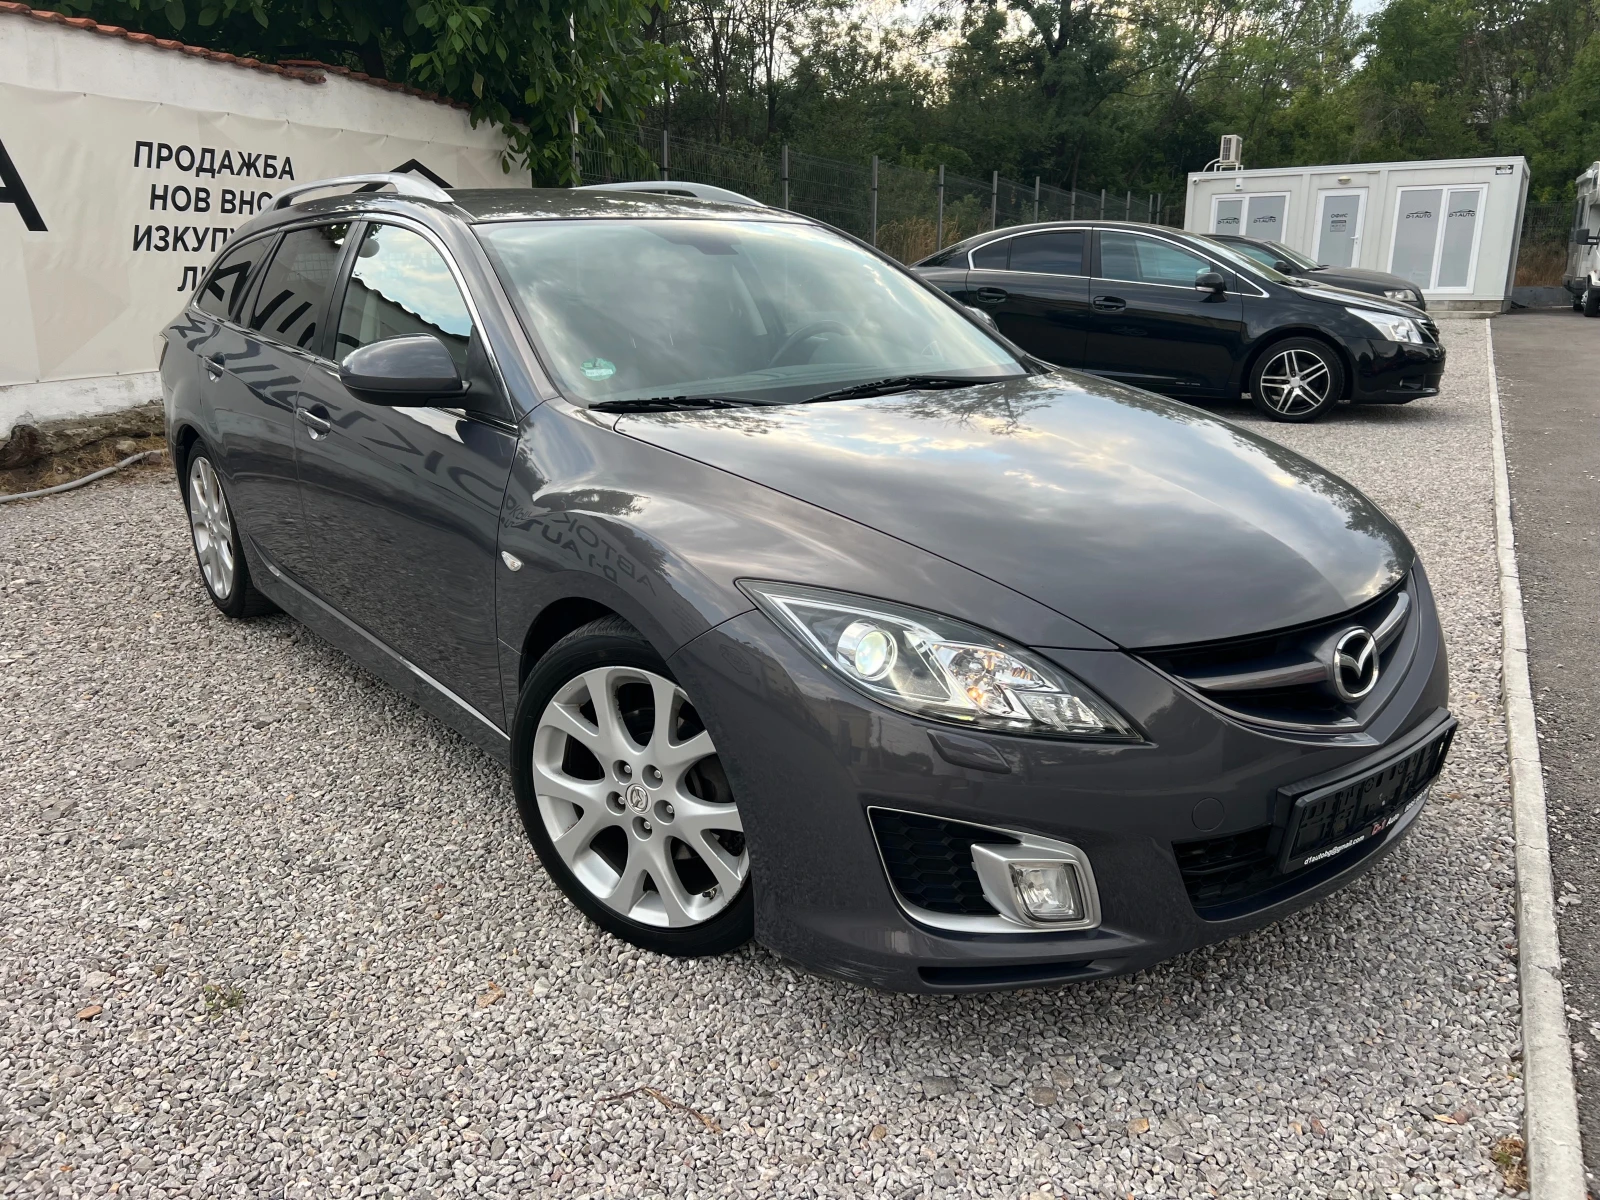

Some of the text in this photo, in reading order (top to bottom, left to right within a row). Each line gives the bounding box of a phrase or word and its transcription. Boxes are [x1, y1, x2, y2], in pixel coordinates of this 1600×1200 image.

[133, 140, 295, 181] ПРОДАЖБА
[149, 183, 211, 213] НОВ
[132, 224, 235, 252] ИЗКУП
